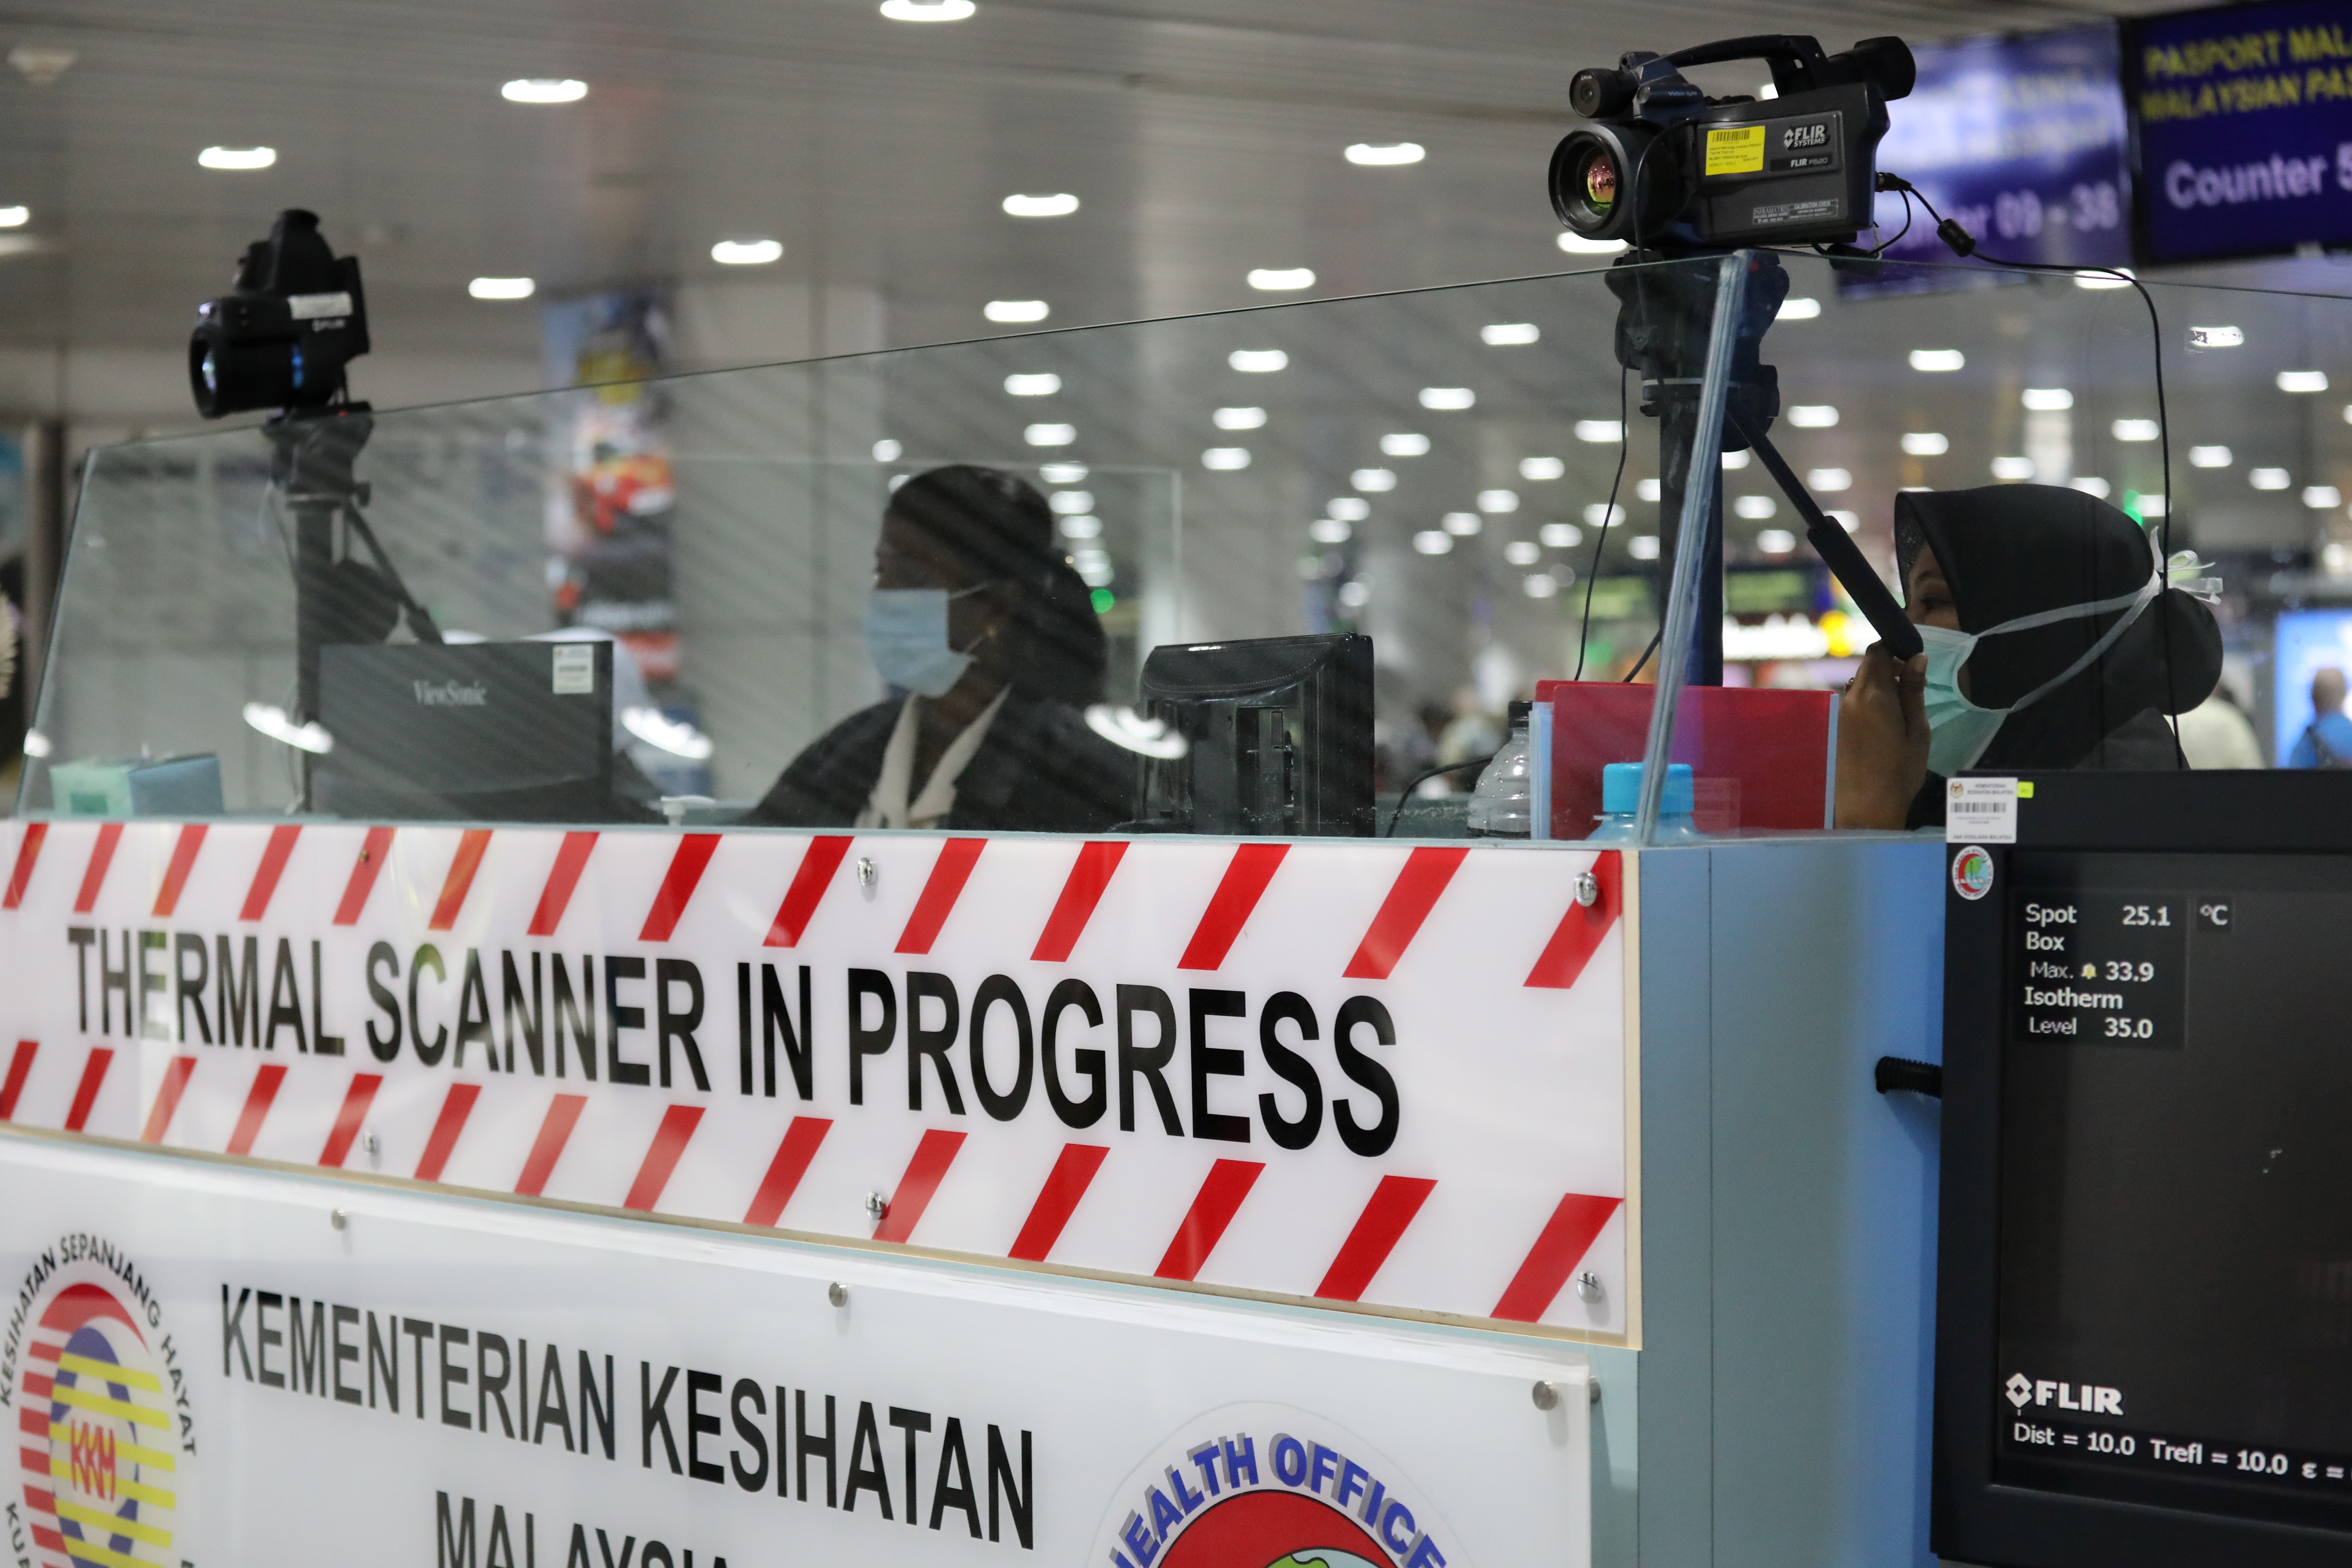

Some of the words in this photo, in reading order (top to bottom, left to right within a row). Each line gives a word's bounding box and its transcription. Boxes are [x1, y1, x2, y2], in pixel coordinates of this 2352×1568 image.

[1794, 125, 1825, 141] FLIR
[1794, 137, 1826, 147] SYSTEMS
[1791, 158, 1807, 167] FLIR
[2165, 153, 2328, 209] Counter
[414, 679, 486, 705] ViewSonic
[2026, 903, 2077, 928] Spot
[2122, 905, 2171, 927] 25.1
[2200, 905, 2228, 925] °C
[2026, 931, 2065, 951] Box
[2030, 961, 2074, 979] Max.
[2106, 961, 2154, 982] 33.9
[2024, 986, 2124, 1010] Isotherm
[2029, 1017, 2077, 1036] Level
[2104, 1017, 2153, 1039] 35.0
[67, 927, 346, 1057] THERMAL
[364, 941, 712, 1092] SCANNER
[737, 962, 813, 1101] IN
[847, 967, 1400, 1158] PROGRESS
[0, 1247, 56, 1407] KESIHATAN
[60, 1233, 162, 1329] SEPANJANG
[161, 1334, 197, 1457] HAYAT
[2035, 1380, 2124, 1416] FLIR
[221, 1283, 616, 1462] KEMENTERIAN
[641, 1359, 1034, 1550] KESIHATAN
[70, 1418, 116, 1503] KKM
[2014, 1422, 2055, 1446] Dist
[2087, 1432, 2135, 1456] 10.0
[2150, 1439, 2203, 1465] Trefl
[2237, 1450, 2288, 1475] 10.0
